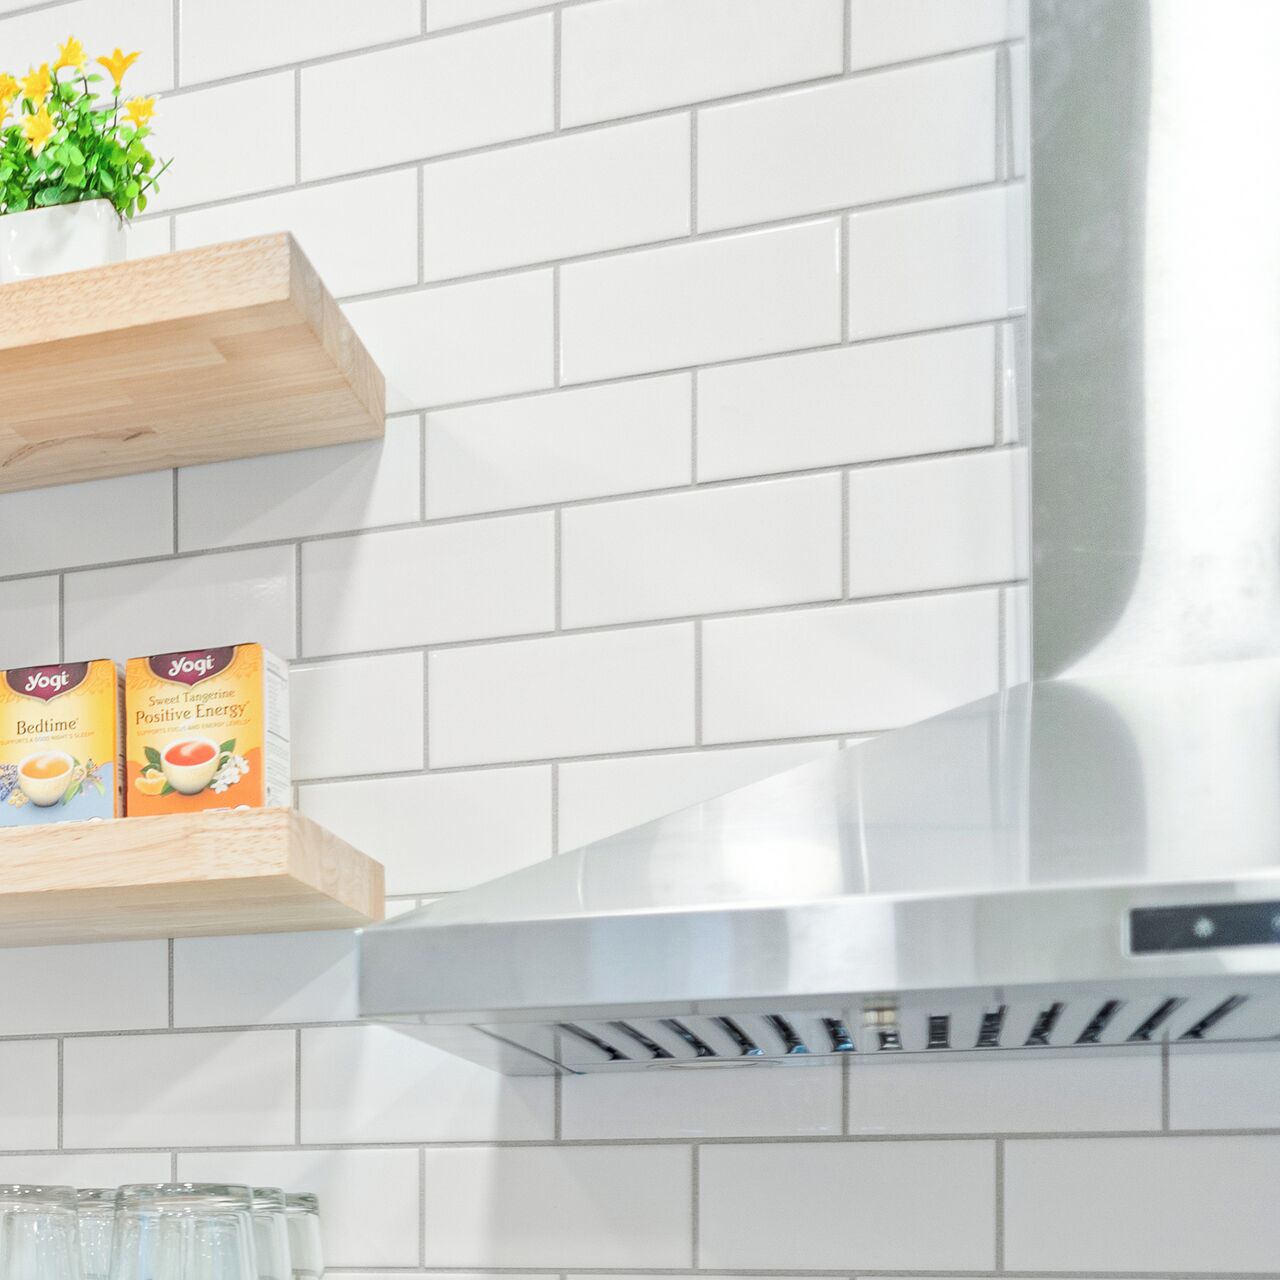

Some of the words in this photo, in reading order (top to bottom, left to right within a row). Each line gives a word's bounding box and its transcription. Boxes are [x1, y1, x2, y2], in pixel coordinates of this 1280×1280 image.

[148, 694, 180, 707] Sweet
[183, 688, 236, 703] Tangerine
[135, 708, 192, 725] Positive
[196, 702, 248, 718] Energy
[16, 718, 78, 735] Bedtime
